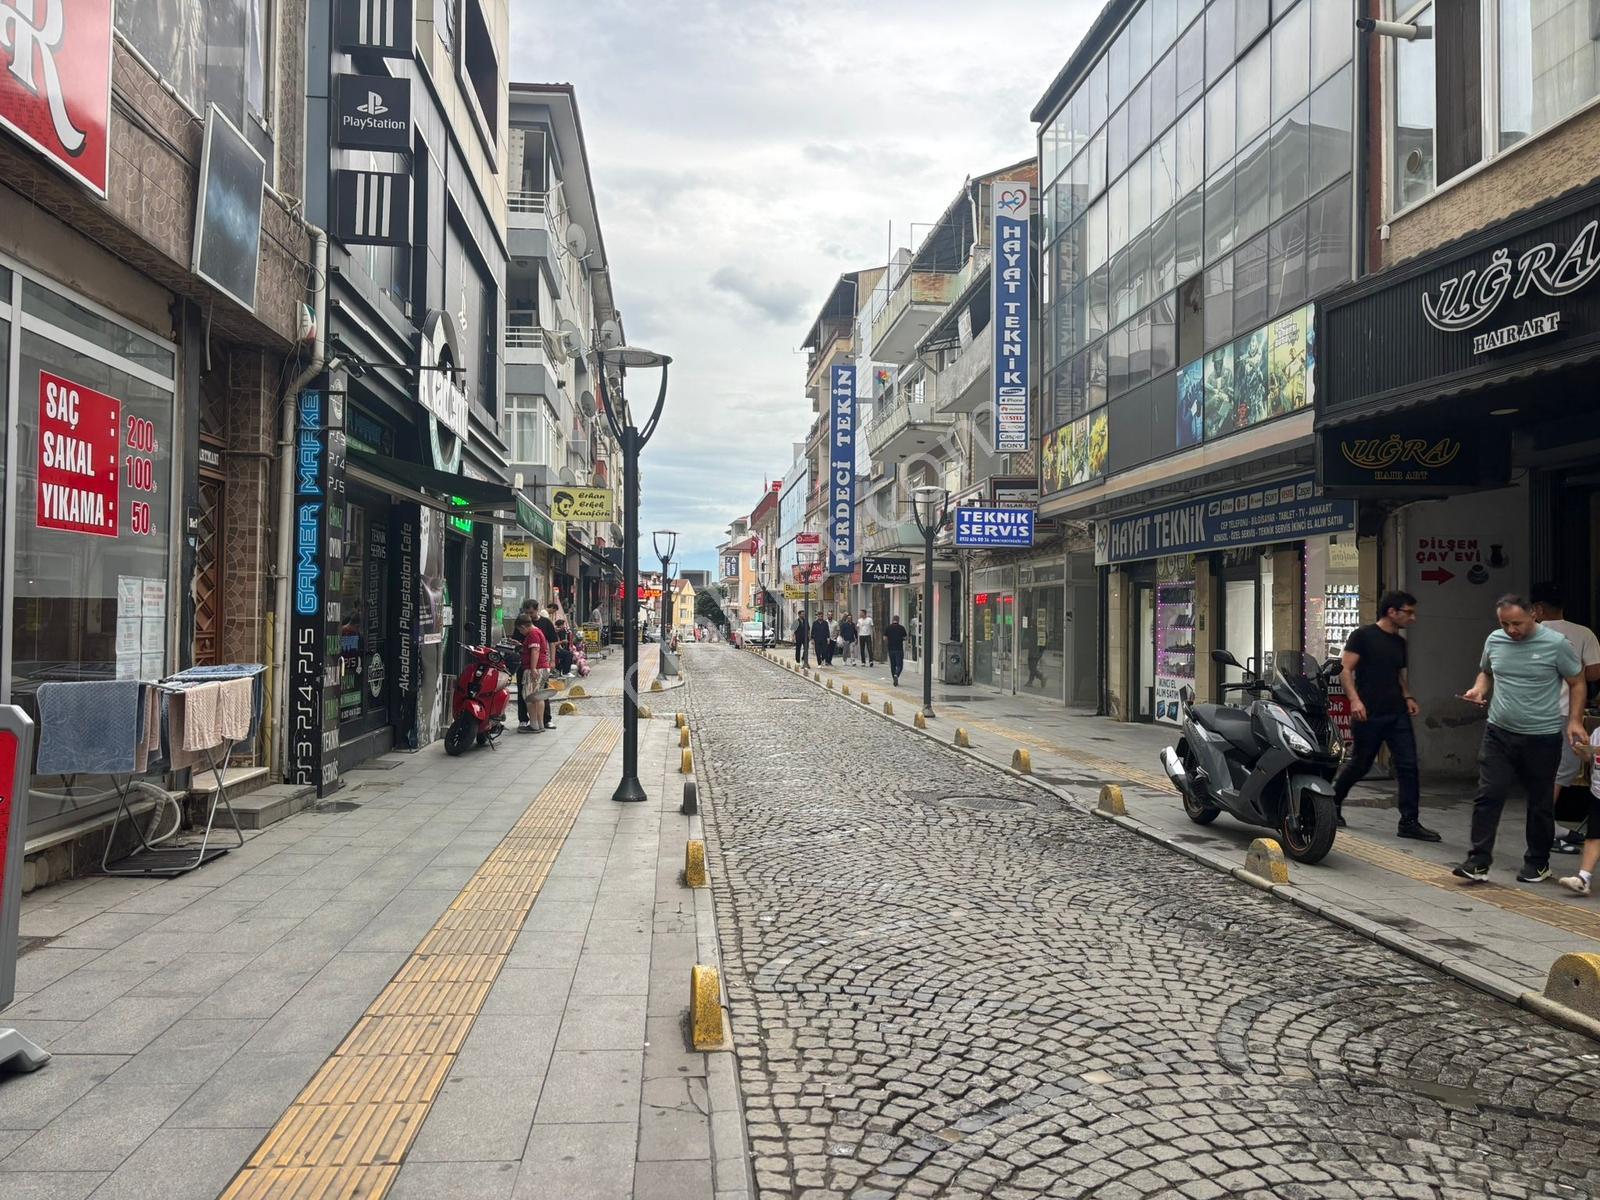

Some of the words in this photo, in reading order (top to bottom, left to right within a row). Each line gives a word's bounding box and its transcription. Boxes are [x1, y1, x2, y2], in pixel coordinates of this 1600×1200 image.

[343, 116, 406, 130] PlayStation
[1003, 226, 1021, 293] HAYAT
[1422, 220, 1600, 332] UĞRA
[1473, 325, 1519, 355] HAIR
[1519, 312, 1560, 341] ART
[46, 382, 80, 430] SAÇ
[832, 369, 852, 447] TEKİN
[43, 430, 95, 477] SAKAL
[329, 431, 346, 446] PS3
[1341, 435, 1460, 469] UĞRA
[328, 453, 345, 470] PS4
[1375, 471, 1403, 480] HAIR
[1406, 471, 1428, 480] ART
[328, 476, 345, 493] PS5
[42, 482, 105, 526] YIKAMA
[572, 509, 610, 518] Kuaförü
[579, 501, 604, 509] Erkek
[832, 460, 851, 567] PERDECİ
[1278, 510, 1295, 521] TABLET
[1298, 509, 1305, 517] TV
[402, 523, 412, 557] Cafe
[480, 539, 489, 561] Cafe
[1111, 517, 1150, 559] HAYAT
[1416, 551, 1449, 564] ÇAY
[1454, 550, 1481, 561] EVİ
[1419, 537, 1478, 551] DİLŞEN
[297, 502, 322, 615] GAMER
[866, 563, 907, 574] ZAFER
[400, 559, 413, 630] Playstation
[479, 561, 489, 615] Playstation
[299, 628, 314, 674] PS5
[399, 631, 410, 692] Akademi
[1166, 689, 1179, 700] SATIM
[1170, 678, 1176, 689] EL
[297, 685, 313, 729] PS4
[297, 741, 313, 785] PS3
